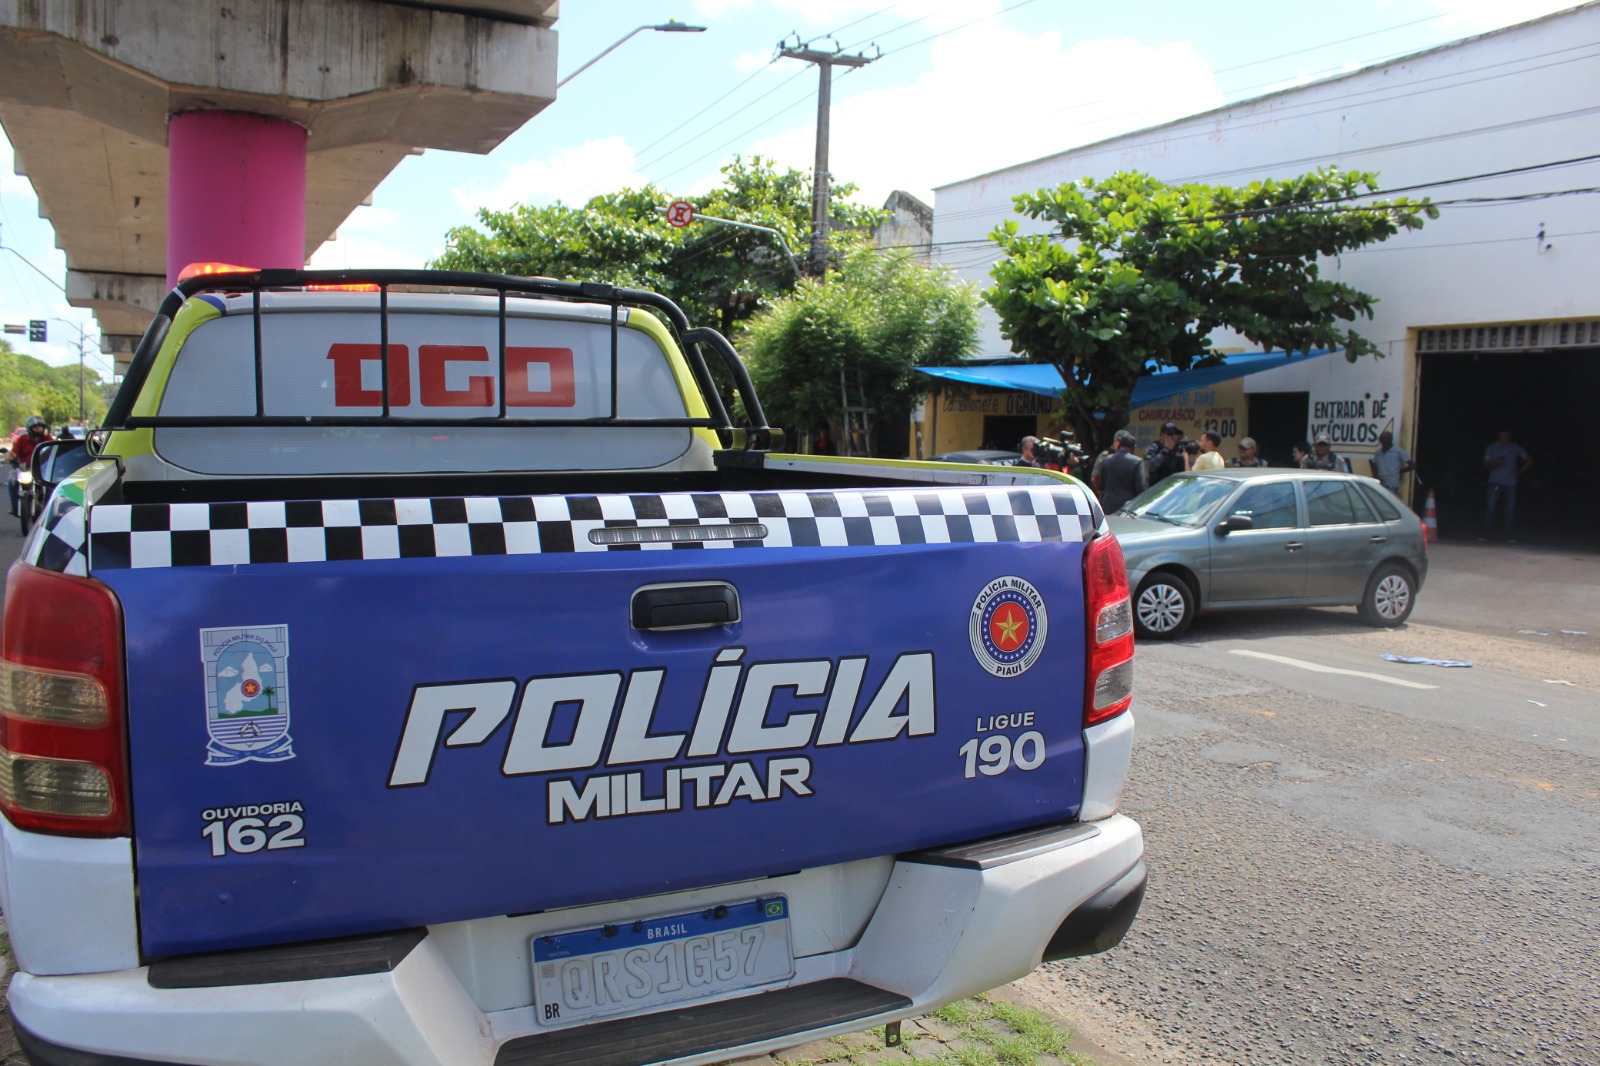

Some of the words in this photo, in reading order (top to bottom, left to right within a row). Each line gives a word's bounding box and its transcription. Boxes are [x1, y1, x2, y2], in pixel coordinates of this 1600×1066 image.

[1138, 408, 1195, 421] CHURRASCO
[1314, 400, 1365, 419] ENTRADA
[1372, 400, 1387, 419] DE
[976, 579, 1008, 611] POLÍCIA
[1010, 579, 1042, 610] MILITAR
[388, 648, 935, 787] POLÍCIA
[976, 711, 1035, 732] LIGUE
[959, 730, 1046, 779] 190
[549, 757, 814, 823] MILITAR
[202, 801, 303, 821] OUVIDORIA
[202, 814, 305, 857] 162
[647, 923, 687, 940] BRASIL
[561, 926, 764, 1010] QRS1G57
[545, 1002, 561, 1020] BR
